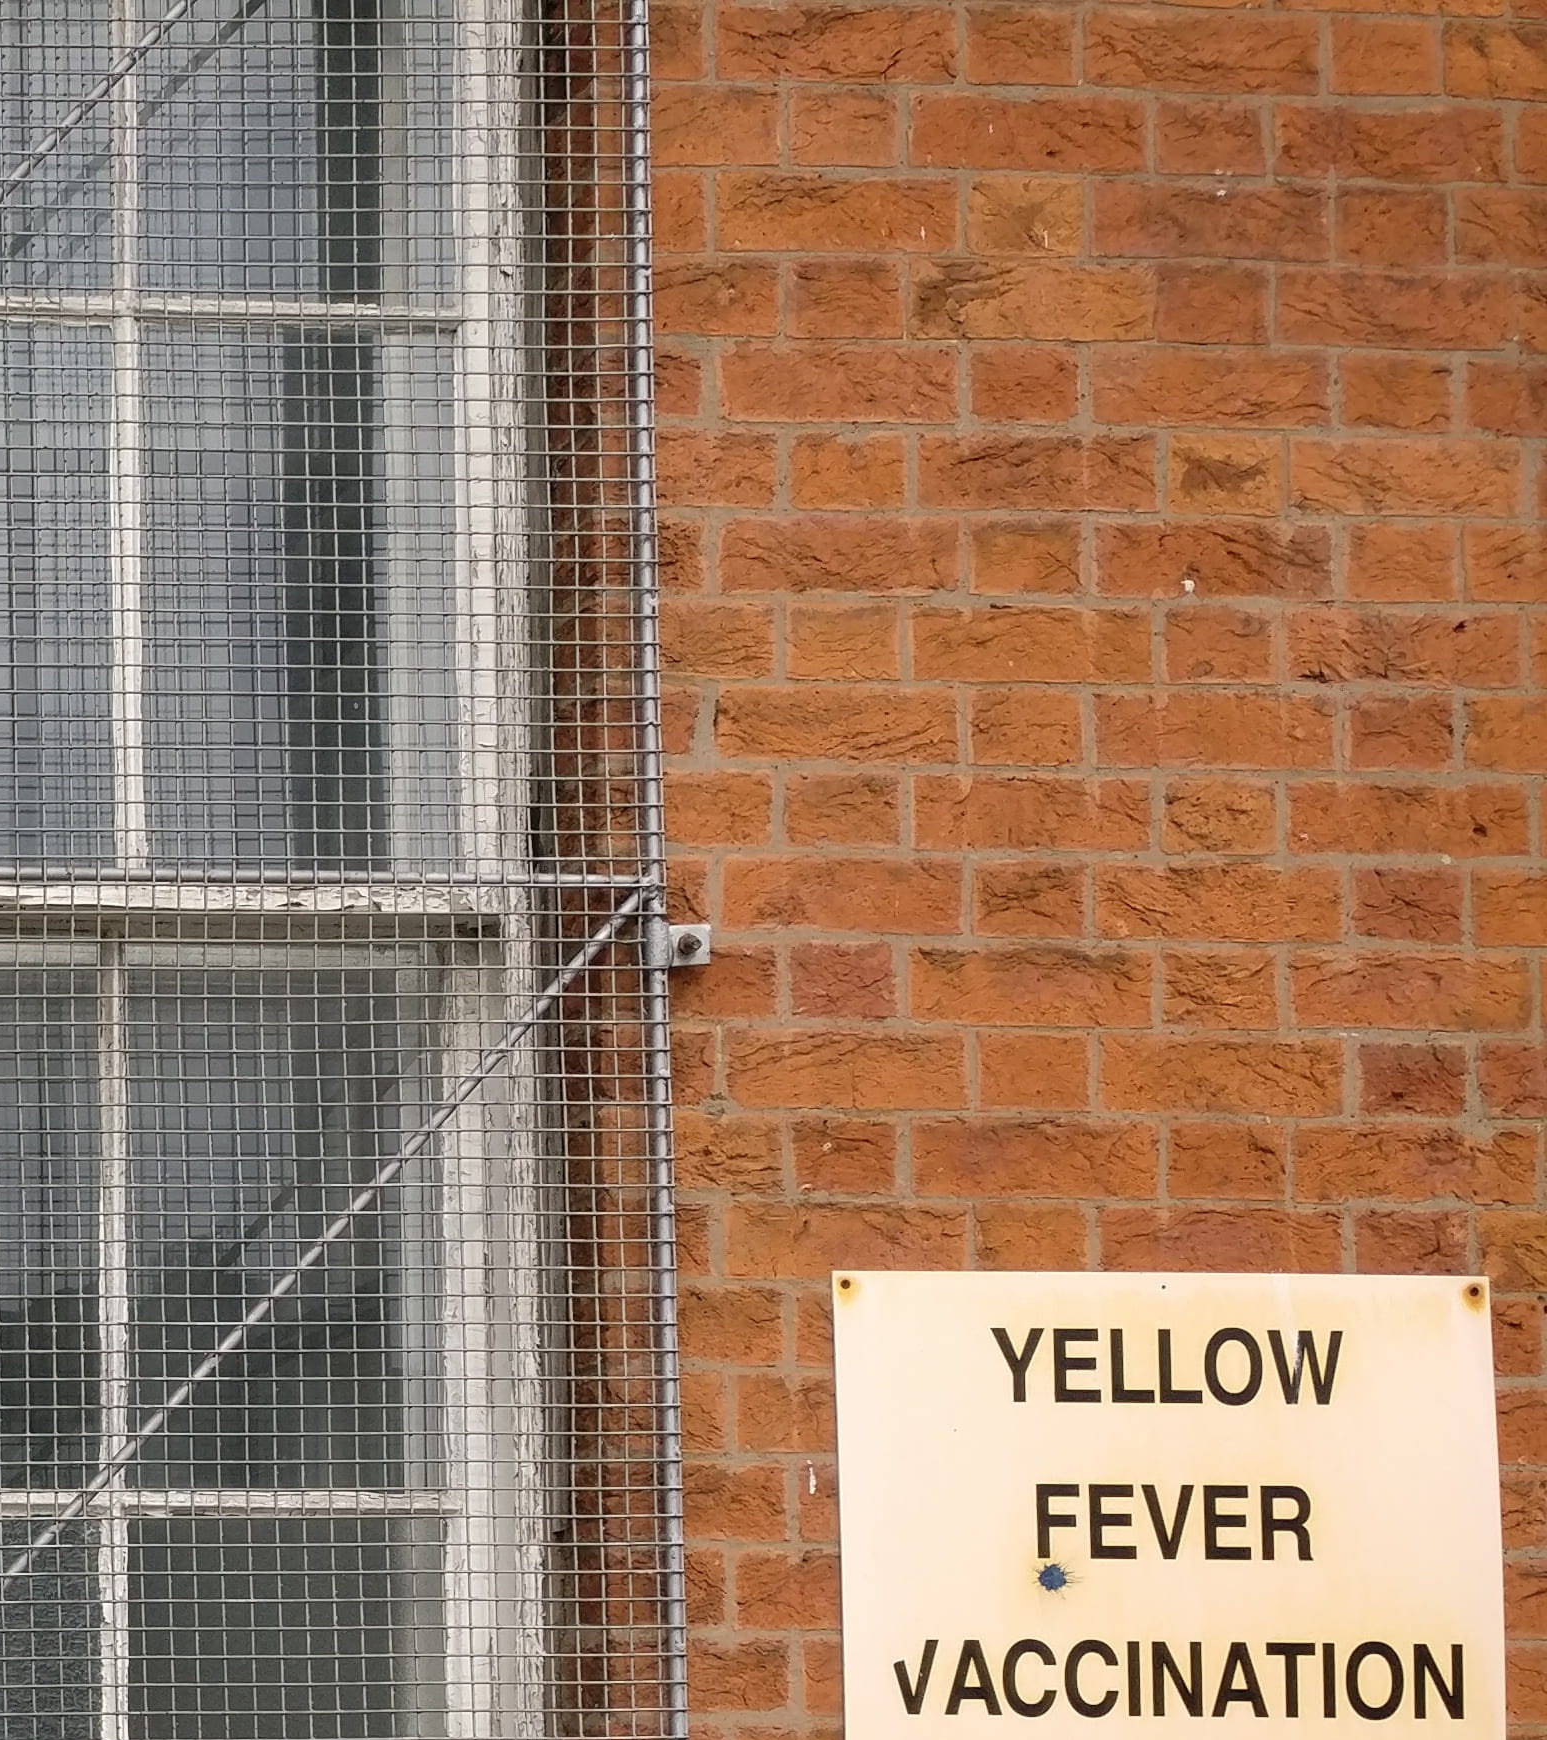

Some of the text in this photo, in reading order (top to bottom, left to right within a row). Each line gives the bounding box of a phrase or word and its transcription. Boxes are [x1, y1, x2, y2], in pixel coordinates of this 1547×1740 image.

[990, 1326, 1344, 1406] YELLOW
[1034, 1483, 1315, 1562] FEVER
[892, 1638, 1465, 1720] VACCINATION
